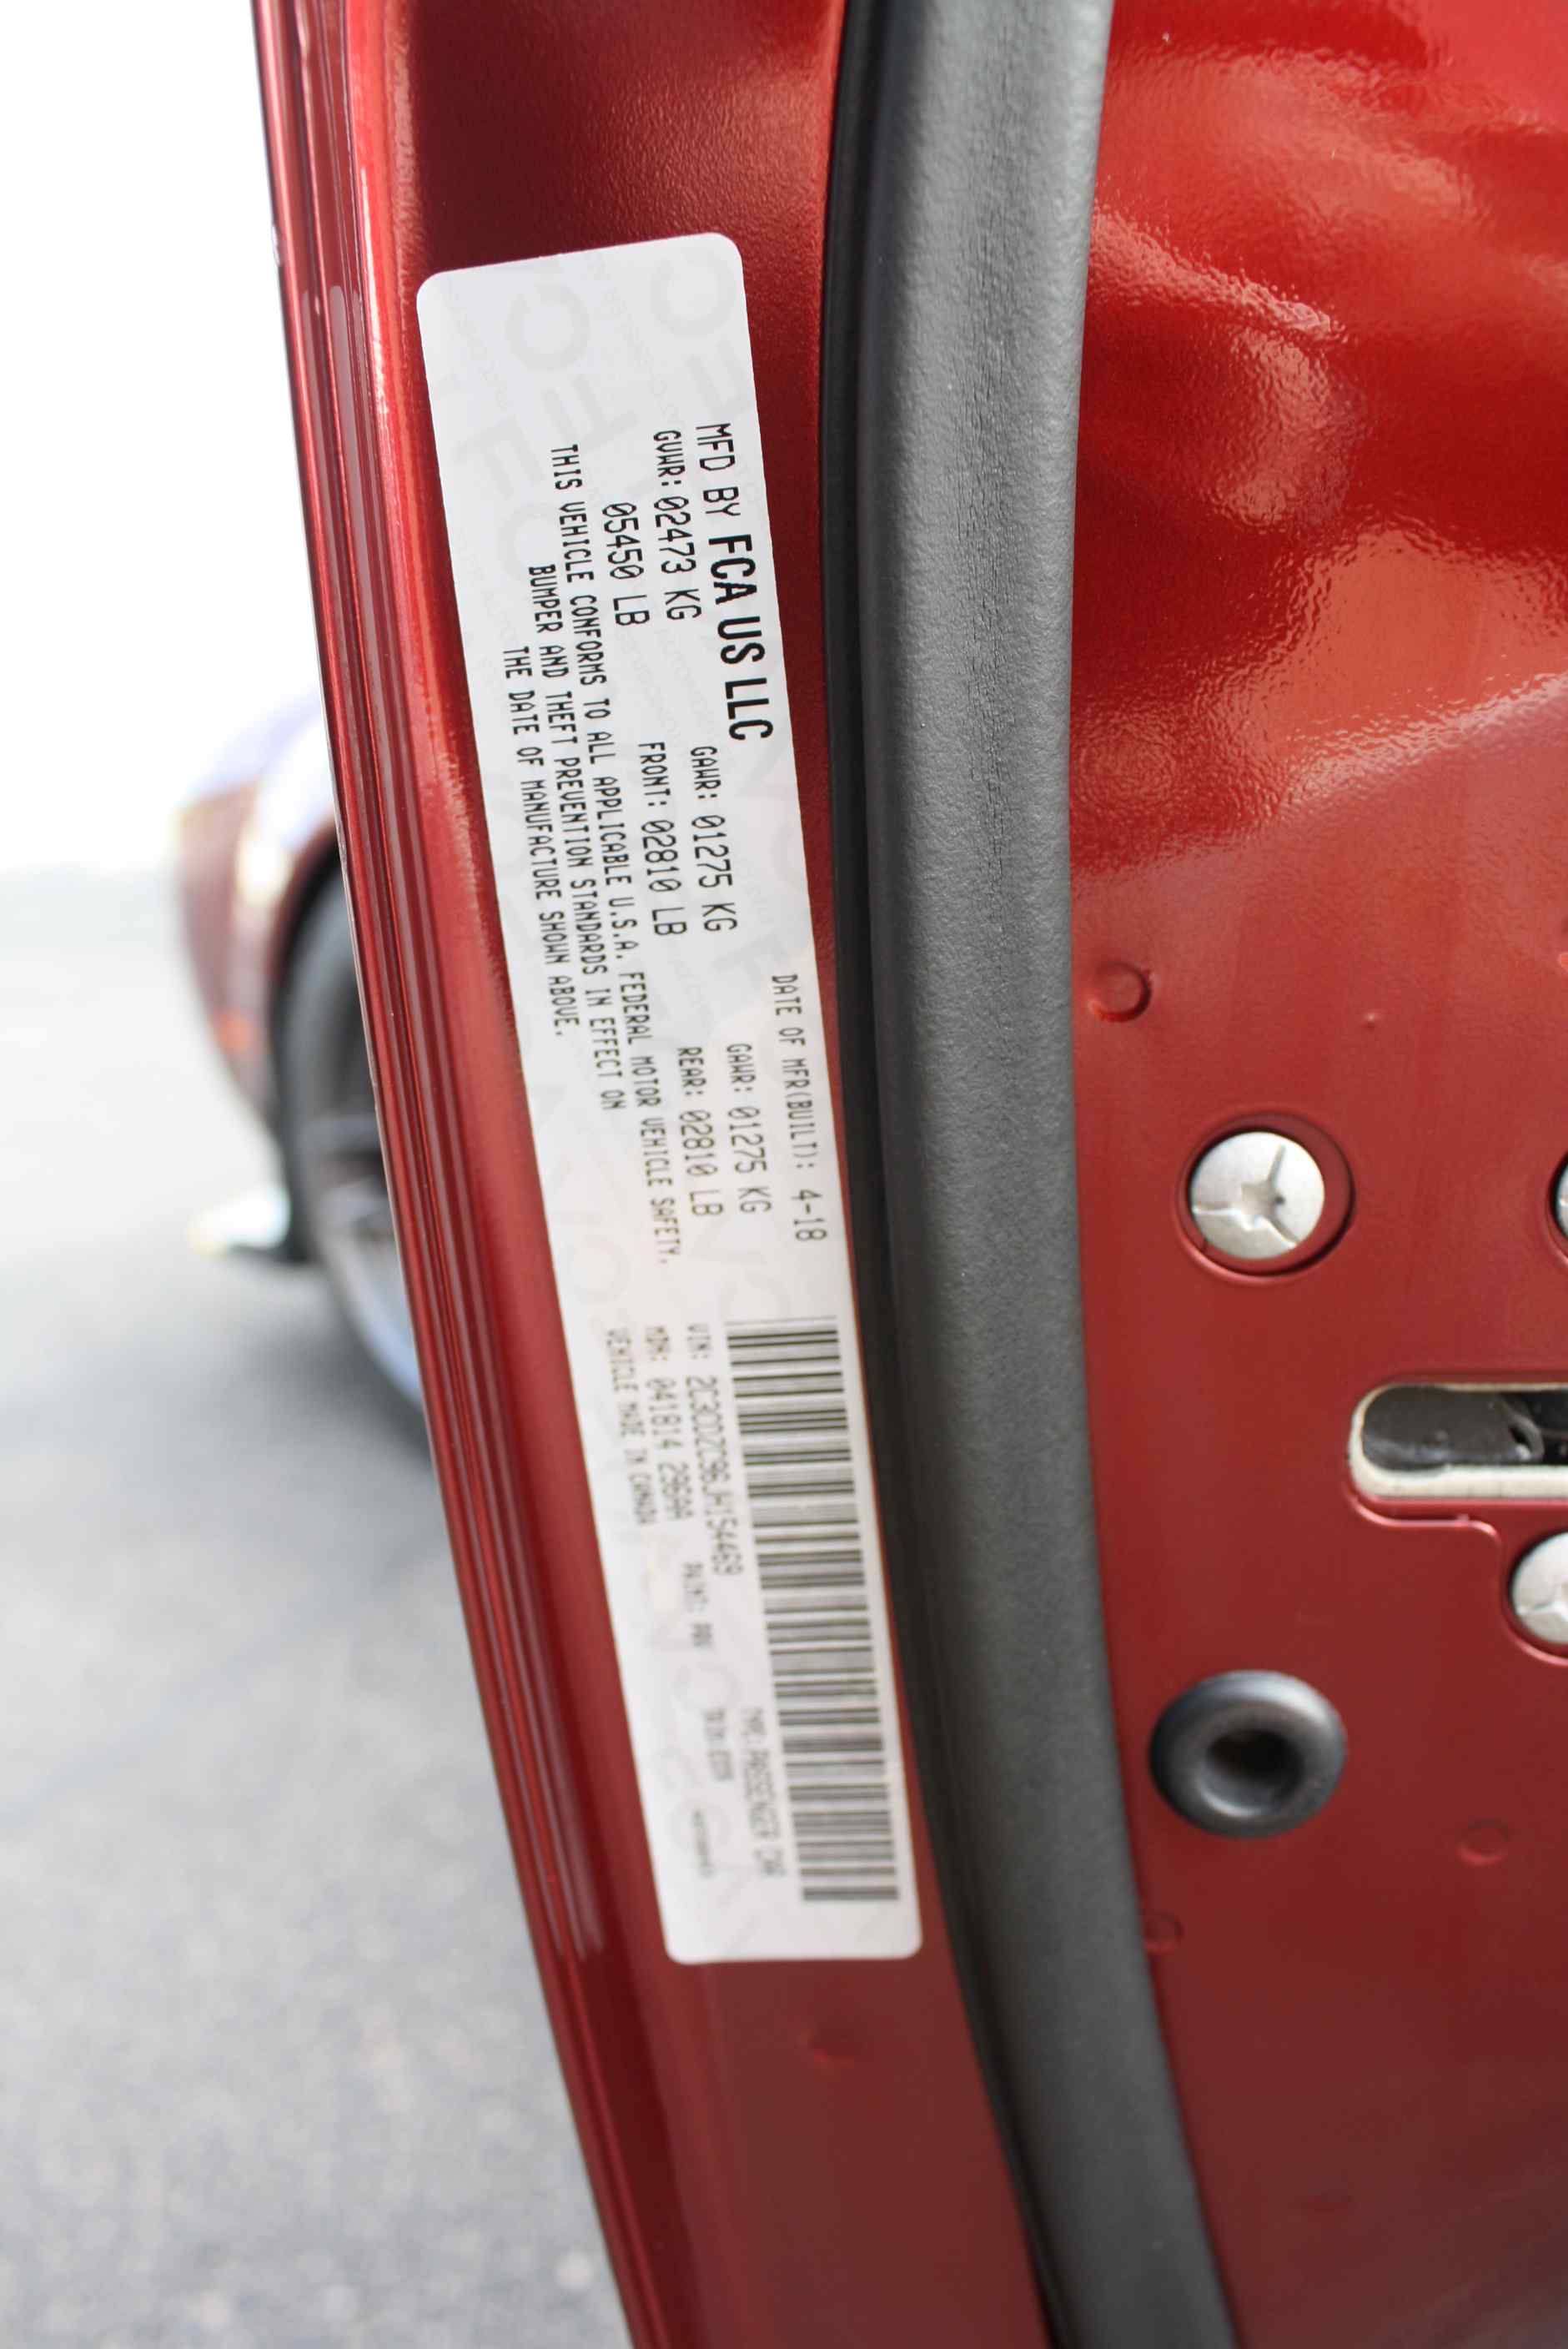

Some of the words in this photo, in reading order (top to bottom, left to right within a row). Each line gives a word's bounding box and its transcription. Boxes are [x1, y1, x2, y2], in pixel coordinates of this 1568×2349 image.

[550, 444, 582, 490] THIS
[653, 430, 685, 485] GVWR:
[696, 423, 735, 470] MFD
[702, 486, 741, 516] BY
[559, 501, 594, 582] VEHICLE
[601, 502, 644, 579] 05450
[653, 495, 696, 573] 02473
[708, 534, 756, 604] FCA
[528, 564, 563, 632] BUMPER
[613, 595, 650, 626] LB
[664, 588, 701, 620] KG
[503, 646, 532, 678] THE
[539, 645, 569, 677] AND
[569, 595, 606, 685] CONFORMS
[716, 616, 765, 664] US
[508, 690, 540, 734] DATE
[545, 691, 577, 743] THEFT
[583, 697, 611, 719] TO
[725, 677, 773, 740] LLC
[516, 747, 544, 766] OF
[586, 731, 615, 764] ALL
[690, 746, 721, 798] GAWR:
[638, 742, 671, 806] FRONT:
[554, 757, 591, 867] PREVENTION
[592, 776, 631, 885] APPLICABLE
[520, 779, 561, 899] MANUFACTURE
[641, 819, 681, 892] 02810
[691, 814, 732, 888] 01275
[538, 911, 568, 963] SHOWN
[570, 878, 607, 974] STANDARDS
[608, 897, 638, 958] U.S.A.
[651, 907, 686, 935] LB
[701, 903, 737, 931] KG
[549, 975, 579, 1034] ABOVE.
[585, 988, 611, 1005] IN
[619, 972, 651, 1044] FEDERAL
[771, 973, 802, 1015] DATE
[589, 1017, 622, 1077] EFFECT
[778, 1027, 806, 1045] OF
[631, 1056, 661, 1106] MOTOR
[677, 1047, 706, 1095] REAR:
[726, 1044, 756, 1092] GAWR:
[600, 1089, 625, 1109] ON
[782, 1058, 817, 1168] MFR(BUILT):
[640, 1117, 672, 1186] VEHICLE
[678, 1110, 717, 1175] 02810
[727, 1106, 767, 1173] 01275
[689, 1190, 724, 1215] LB
[739, 1187, 771, 1212] KG
[792, 1189, 827, 1240] 4-18
